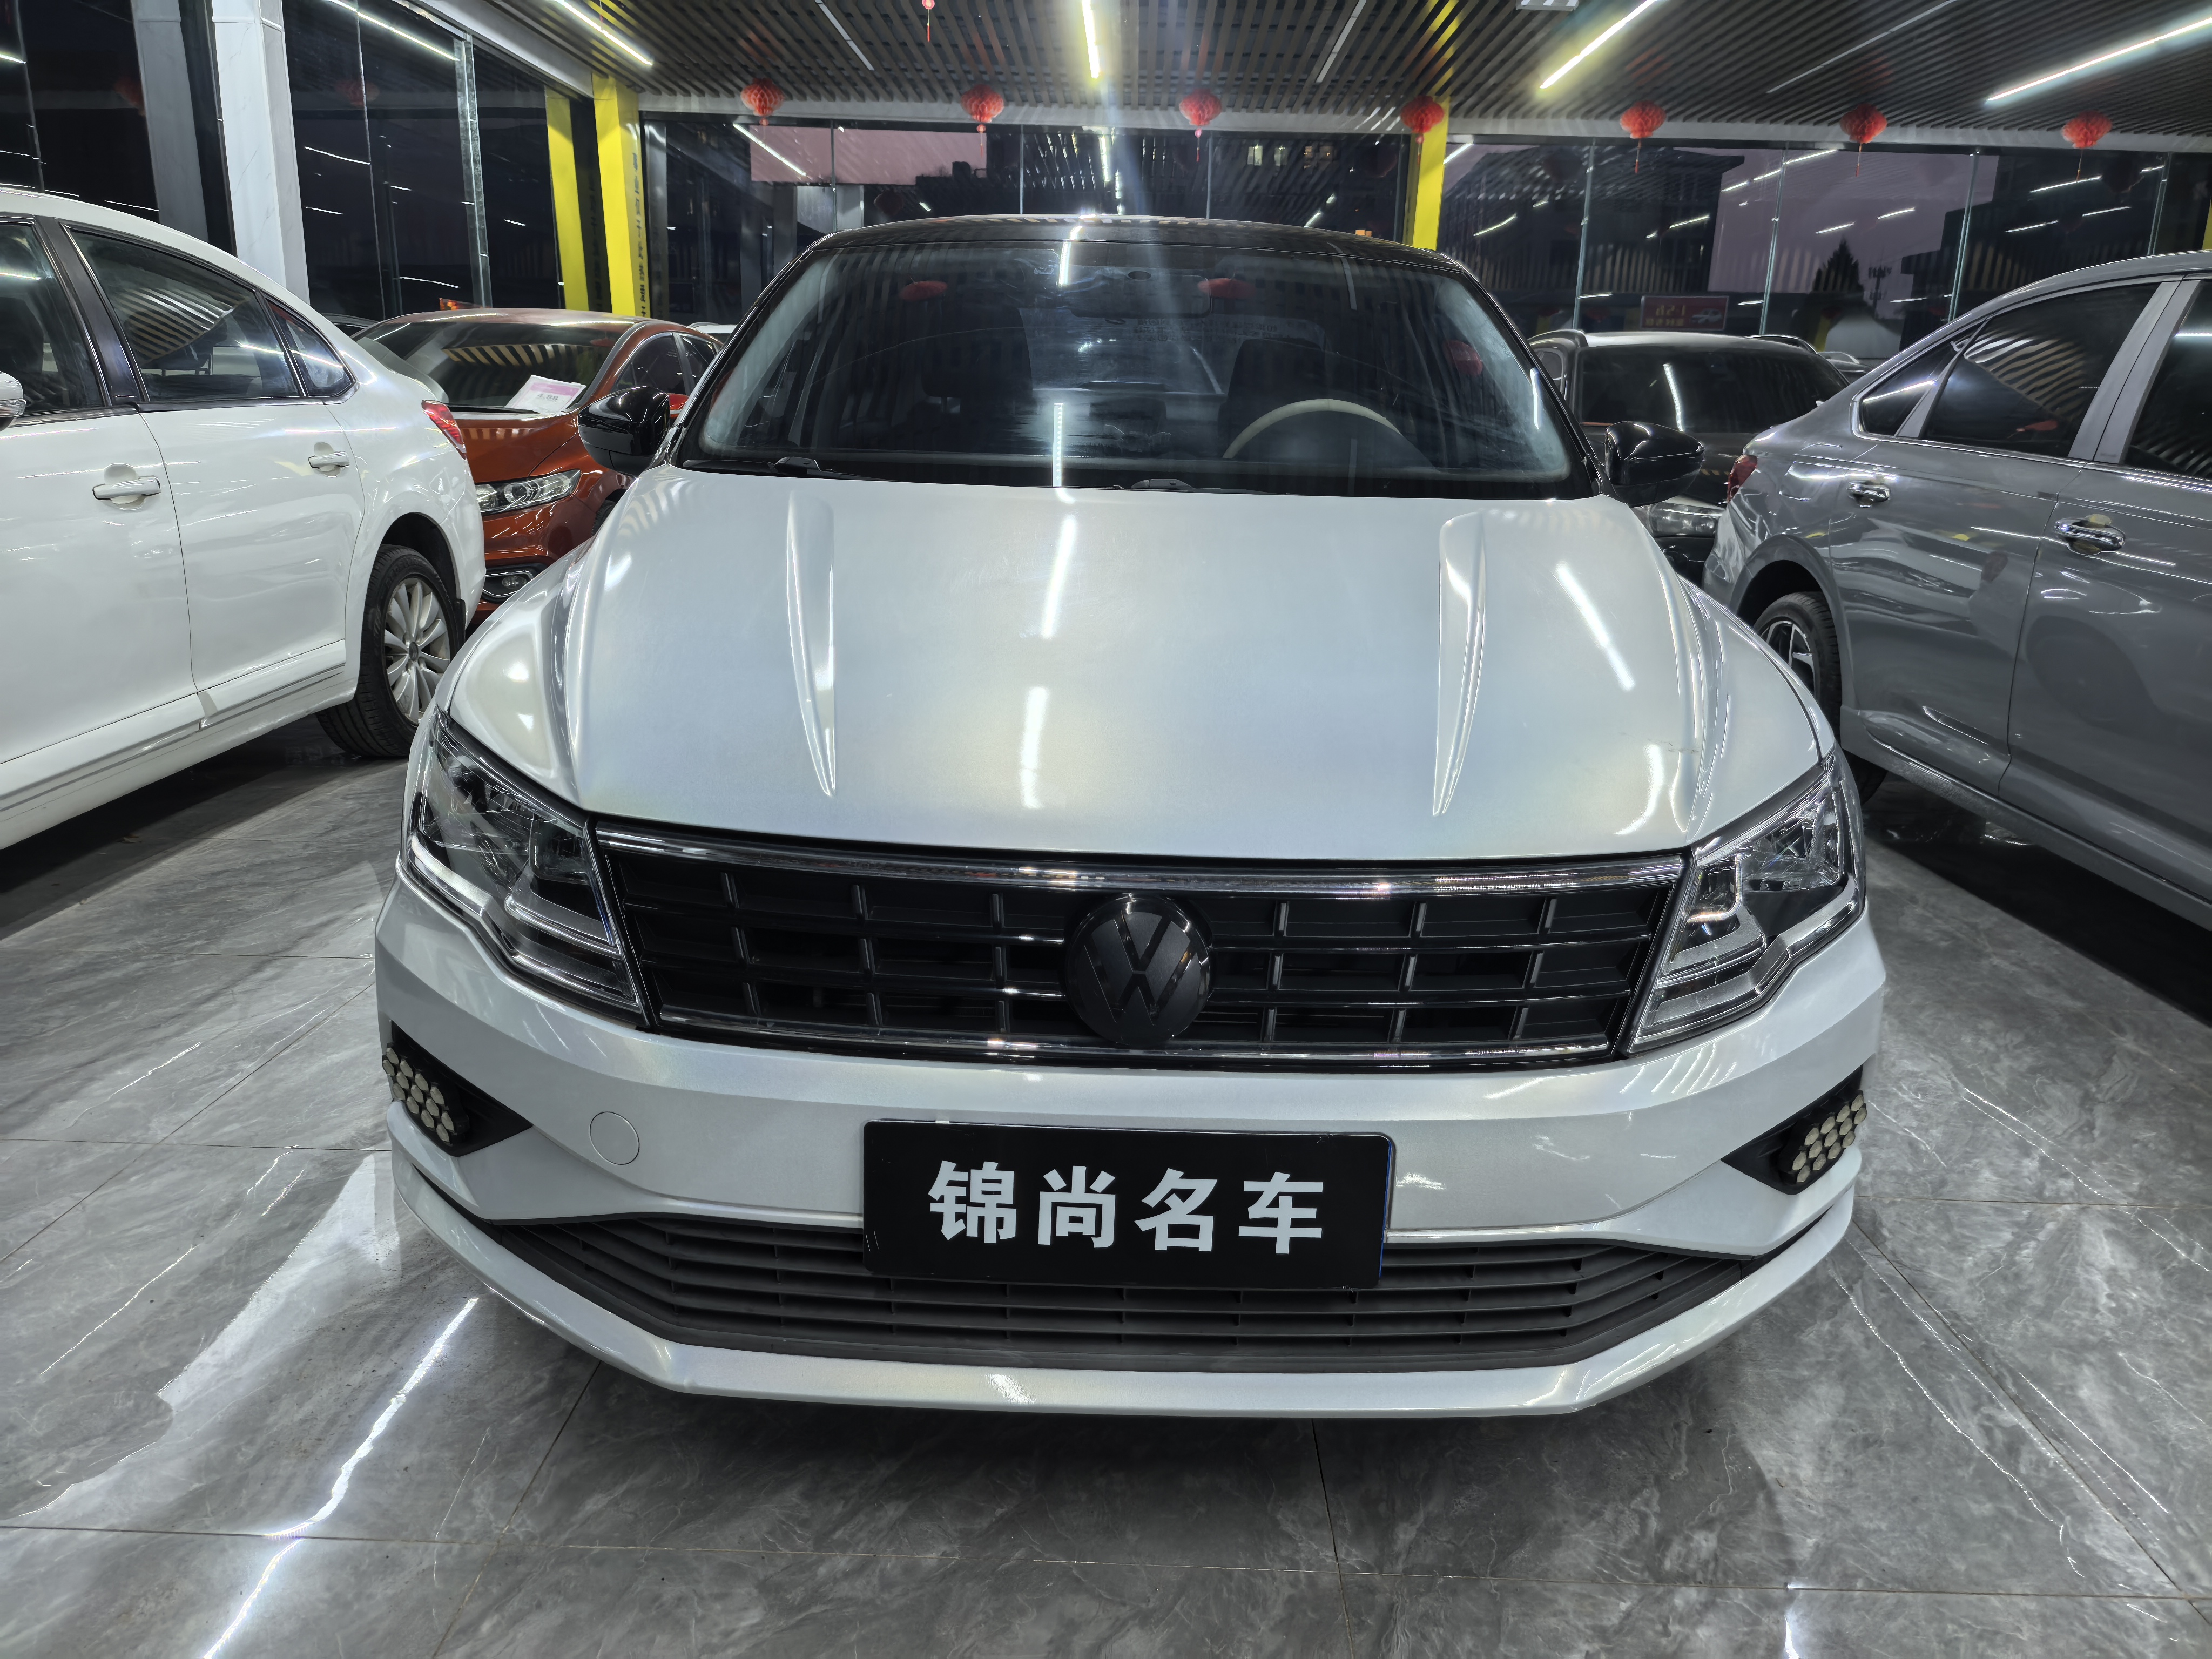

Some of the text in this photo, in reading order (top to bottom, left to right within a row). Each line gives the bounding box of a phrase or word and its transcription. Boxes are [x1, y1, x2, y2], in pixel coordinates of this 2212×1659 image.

[1079, 908, 1200, 1029] VW
[928, 1161, 1323, 1253] 锦尚名车
